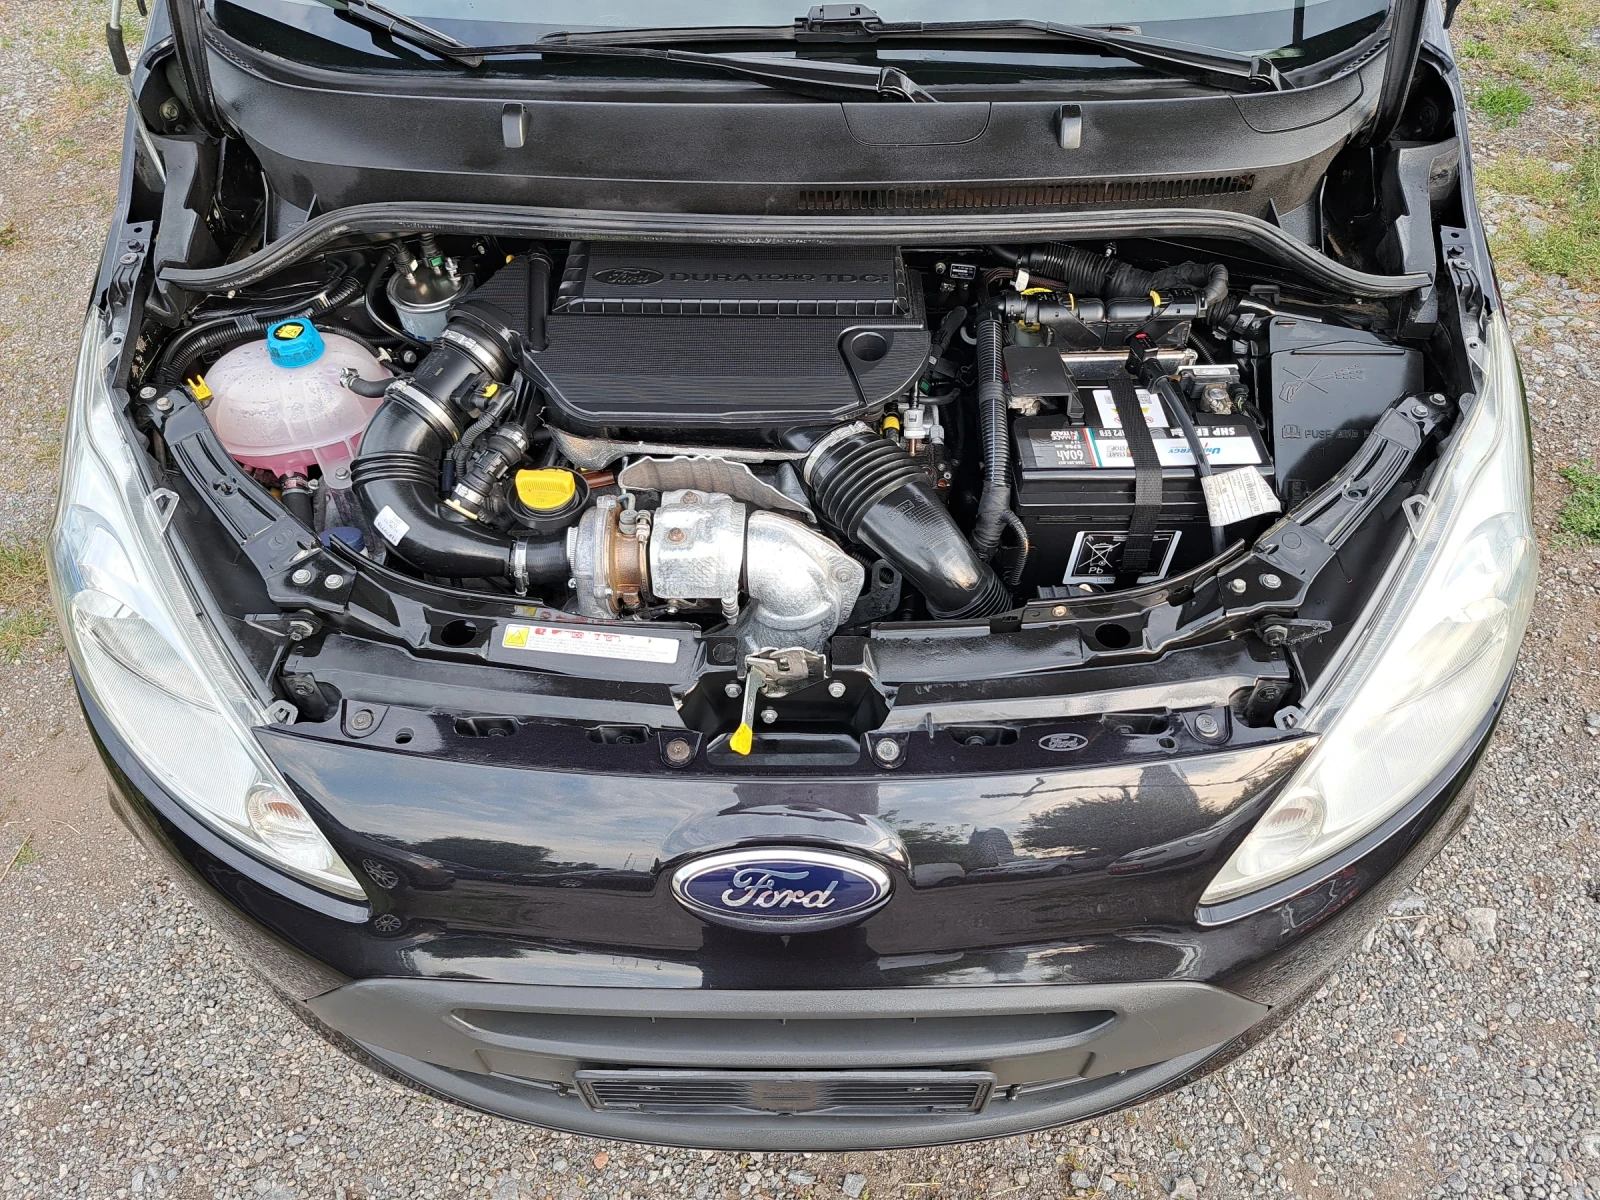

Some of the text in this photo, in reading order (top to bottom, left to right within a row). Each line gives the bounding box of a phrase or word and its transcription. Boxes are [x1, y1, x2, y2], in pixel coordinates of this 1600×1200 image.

[1212, 427, 1236, 436] SHP
[1056, 450, 1084, 460] 60Ah
[1088, 566, 1104, 574] Pb
[1048, 734, 1078, 749] Ford
[721, 868, 839, 909] Ford
